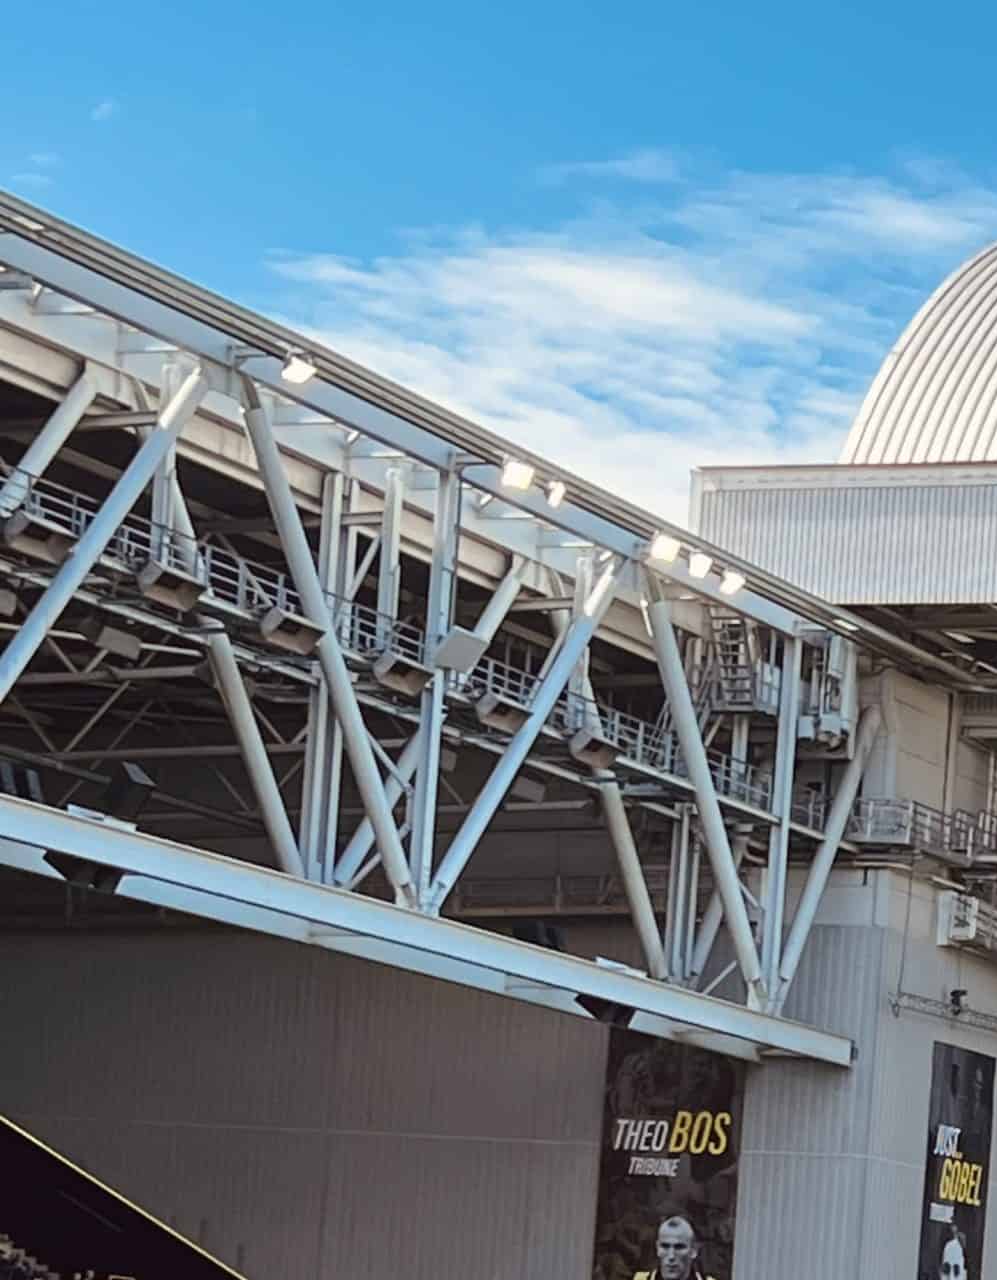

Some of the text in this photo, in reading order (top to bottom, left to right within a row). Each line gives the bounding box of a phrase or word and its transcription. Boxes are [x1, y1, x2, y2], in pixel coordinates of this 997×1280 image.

[614, 1110, 732, 1155] THEO BOS
[628, 1156, 681, 1177] TRIBUNE
